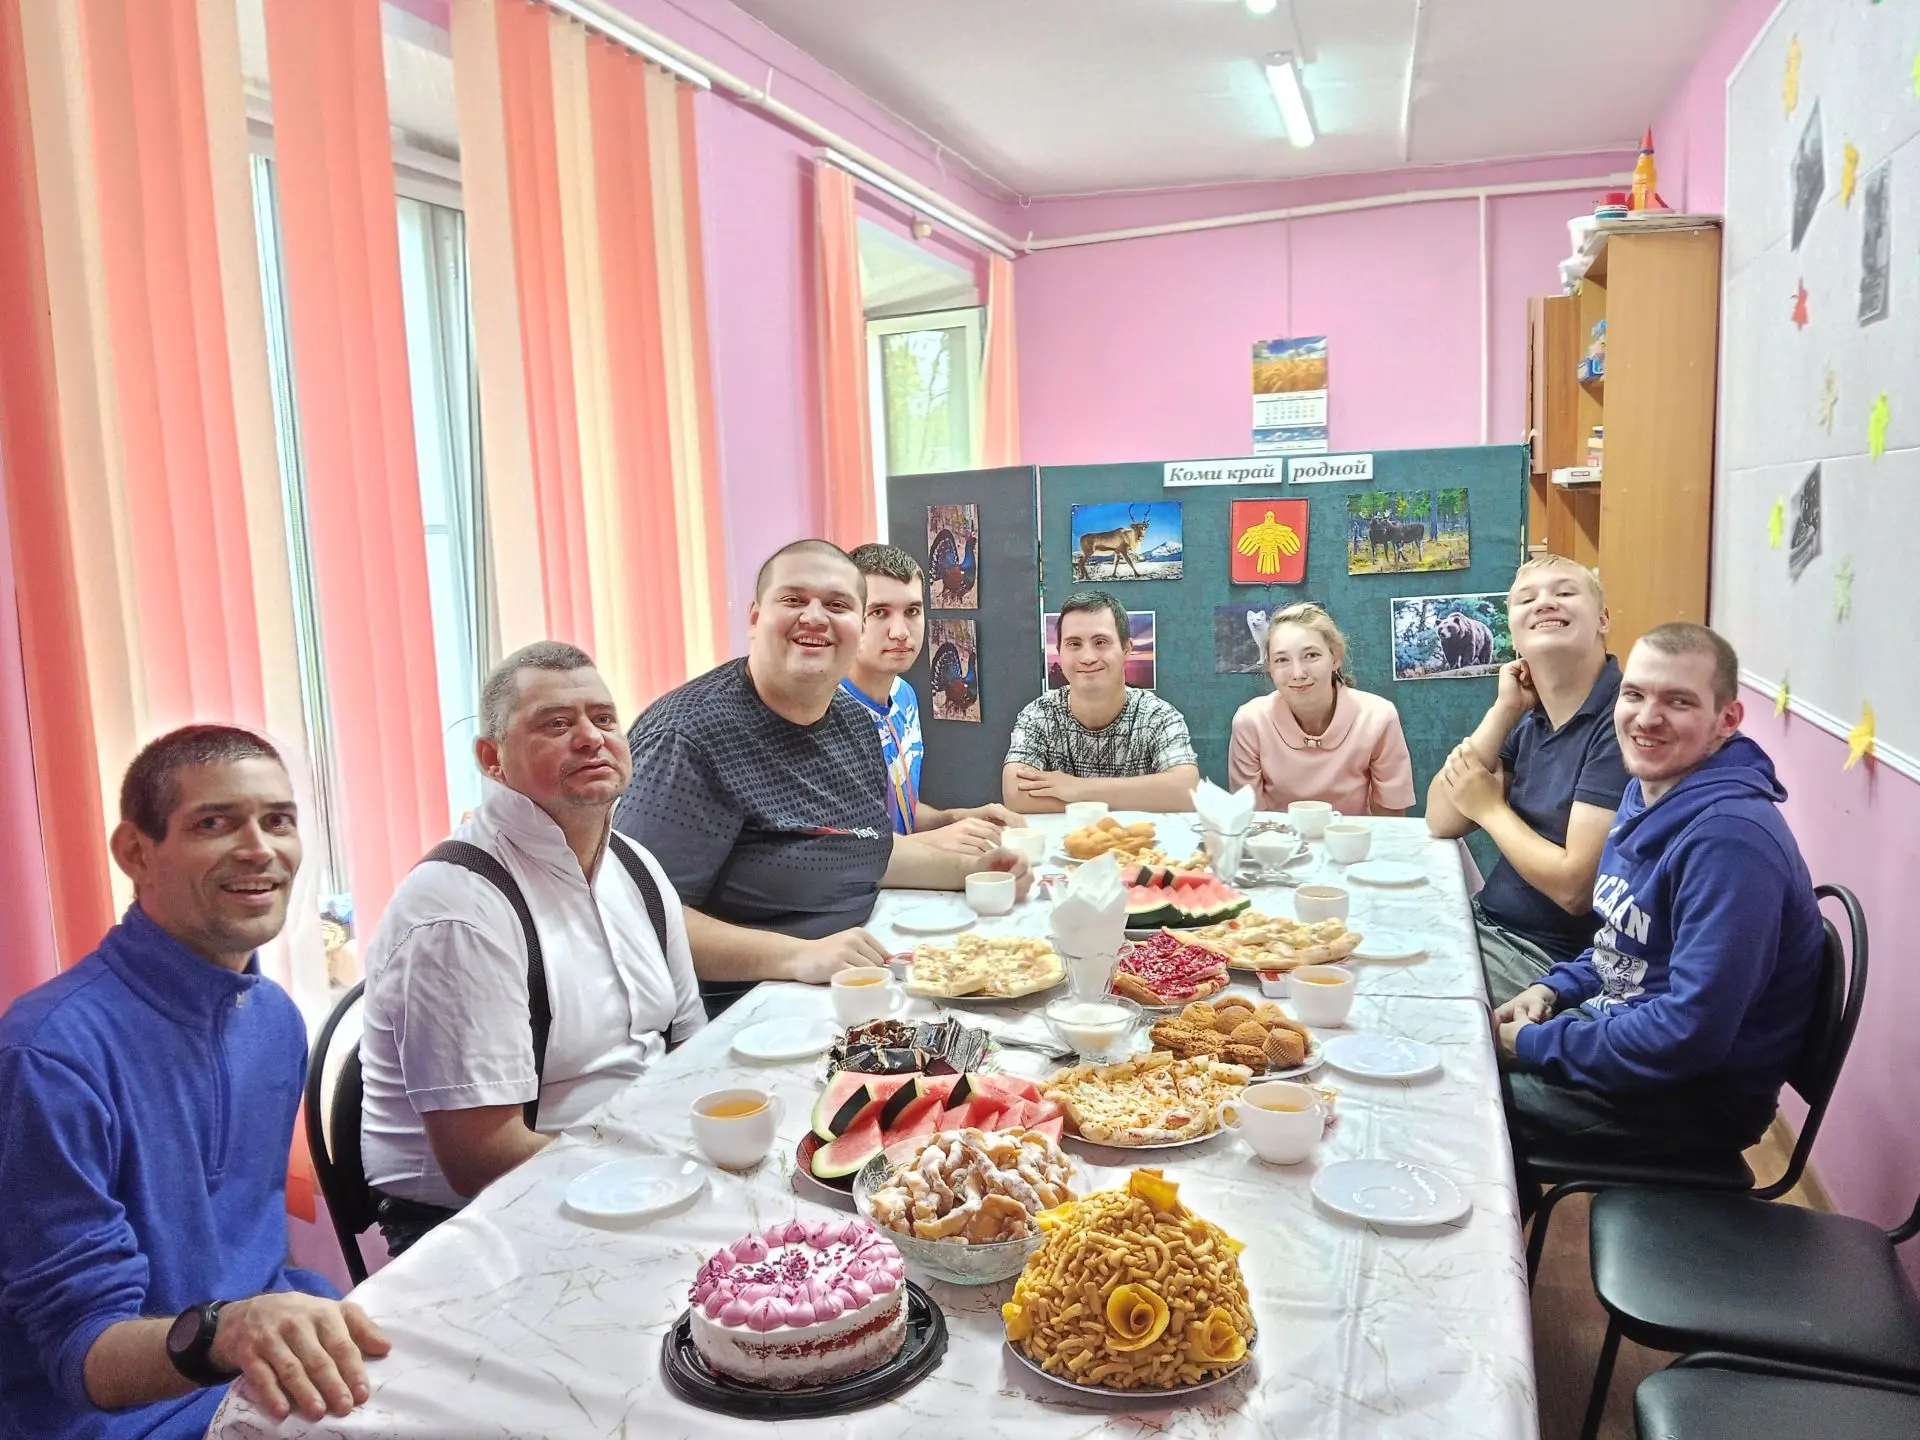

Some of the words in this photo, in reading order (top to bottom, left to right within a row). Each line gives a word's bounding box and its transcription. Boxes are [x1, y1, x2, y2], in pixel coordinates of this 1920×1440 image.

[1169, 467, 1222, 482] Коми
[1227, 464, 1275, 483] край
[1292, 460, 1367, 481] родной
